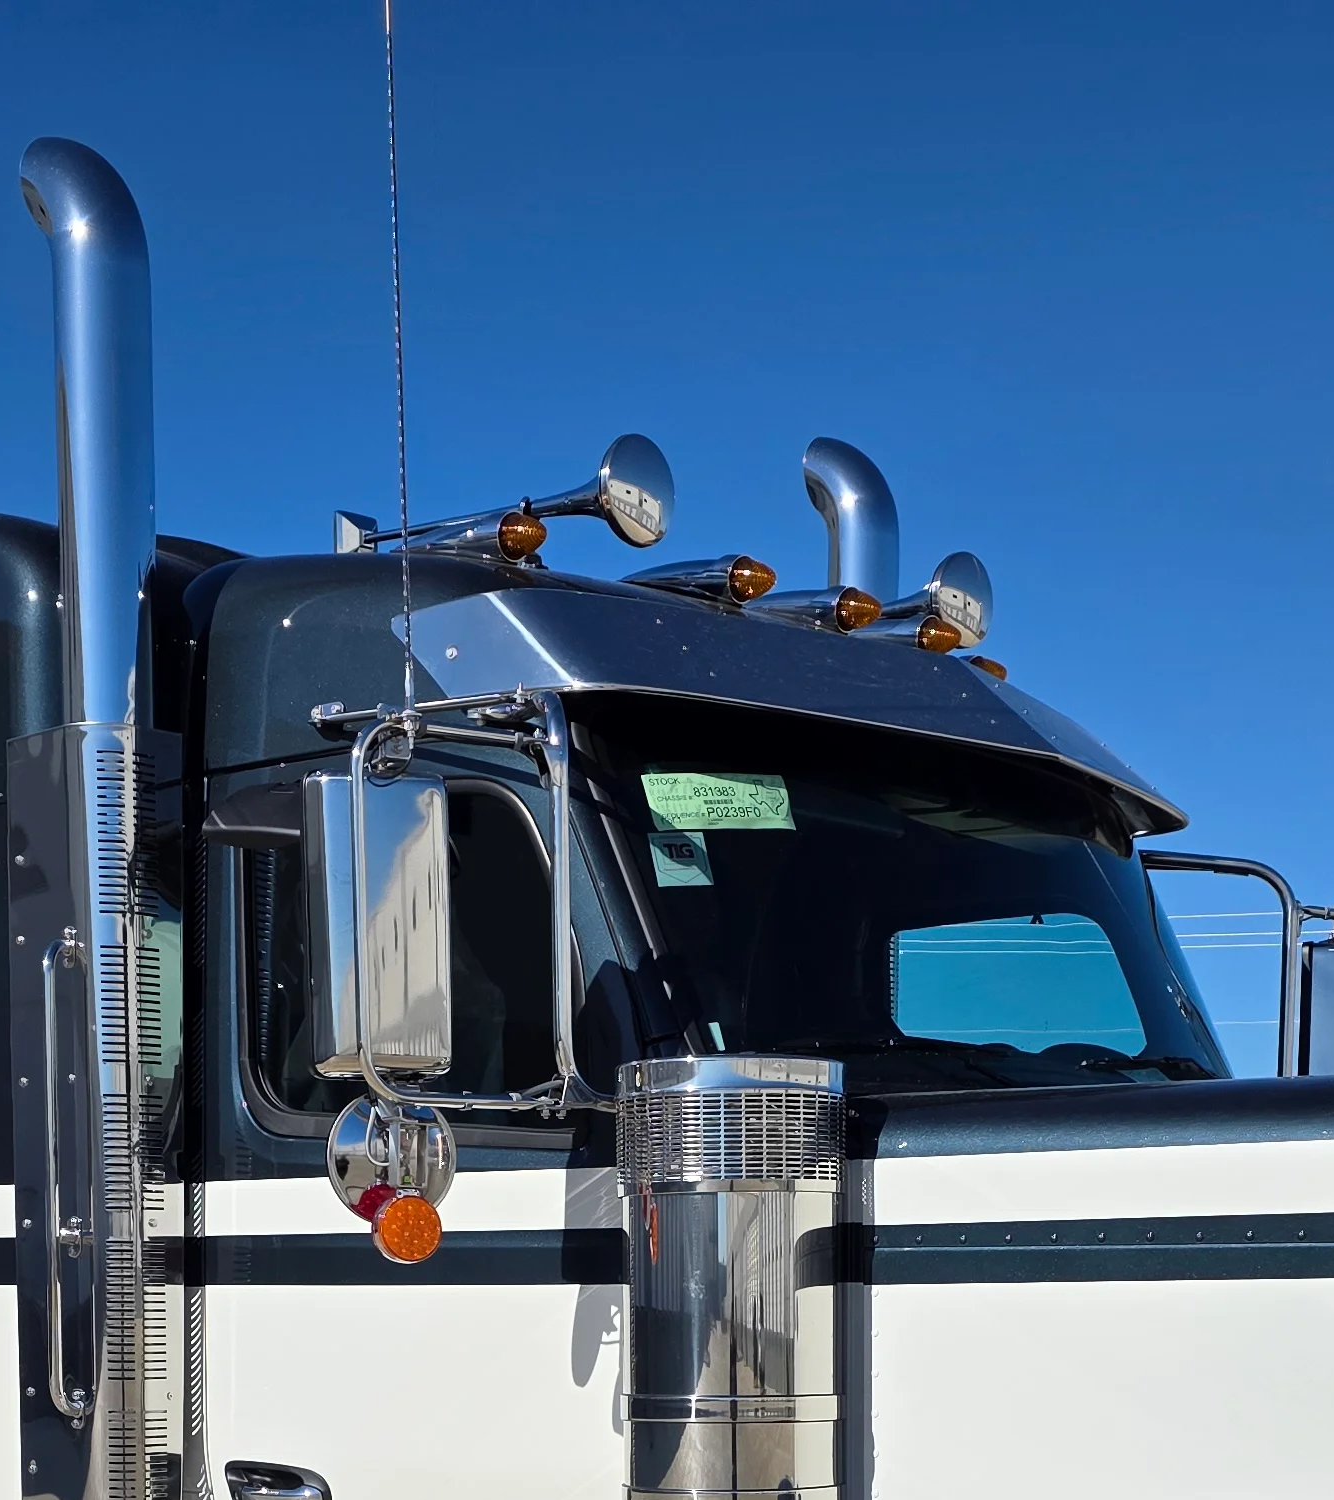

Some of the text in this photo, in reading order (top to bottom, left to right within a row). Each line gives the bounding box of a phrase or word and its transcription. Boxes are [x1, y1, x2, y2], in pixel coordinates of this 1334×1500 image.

[648, 777, 681, 787] STOCK
[693, 786, 736, 797] 831383
[706, 806, 761, 818] P0239F0
[662, 843, 695, 859] TLG
